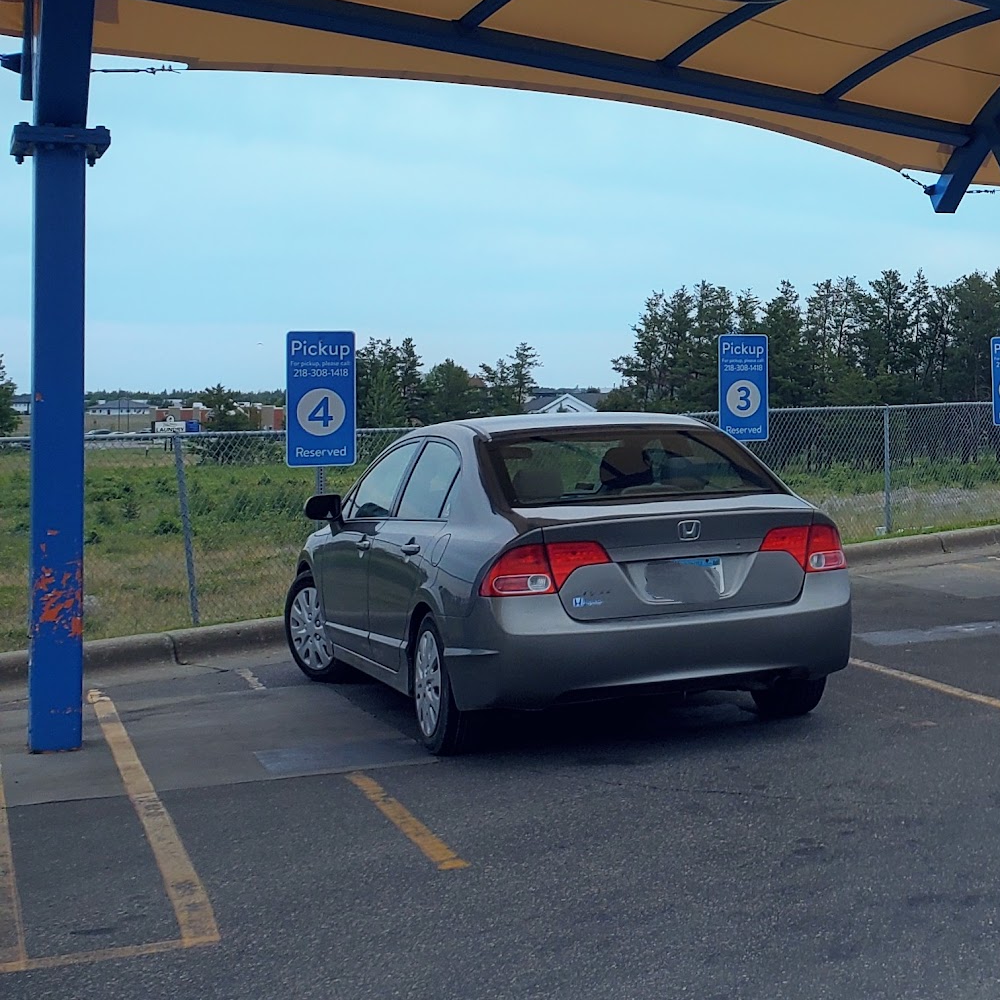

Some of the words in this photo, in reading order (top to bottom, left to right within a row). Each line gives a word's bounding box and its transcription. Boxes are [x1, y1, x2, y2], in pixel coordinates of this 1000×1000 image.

[291, 340, 350, 360] Pickup
[722, 342, 764, 358] Pickup
[293, 368, 349, 377] 218-308-1418
[723, 364, 763, 372] 218-308-1418
[736, 386, 751, 411] 3
[307, 396, 334, 428] 4
[725, 425, 762, 434] Reserved
[295, 446, 347, 458] Reserved
